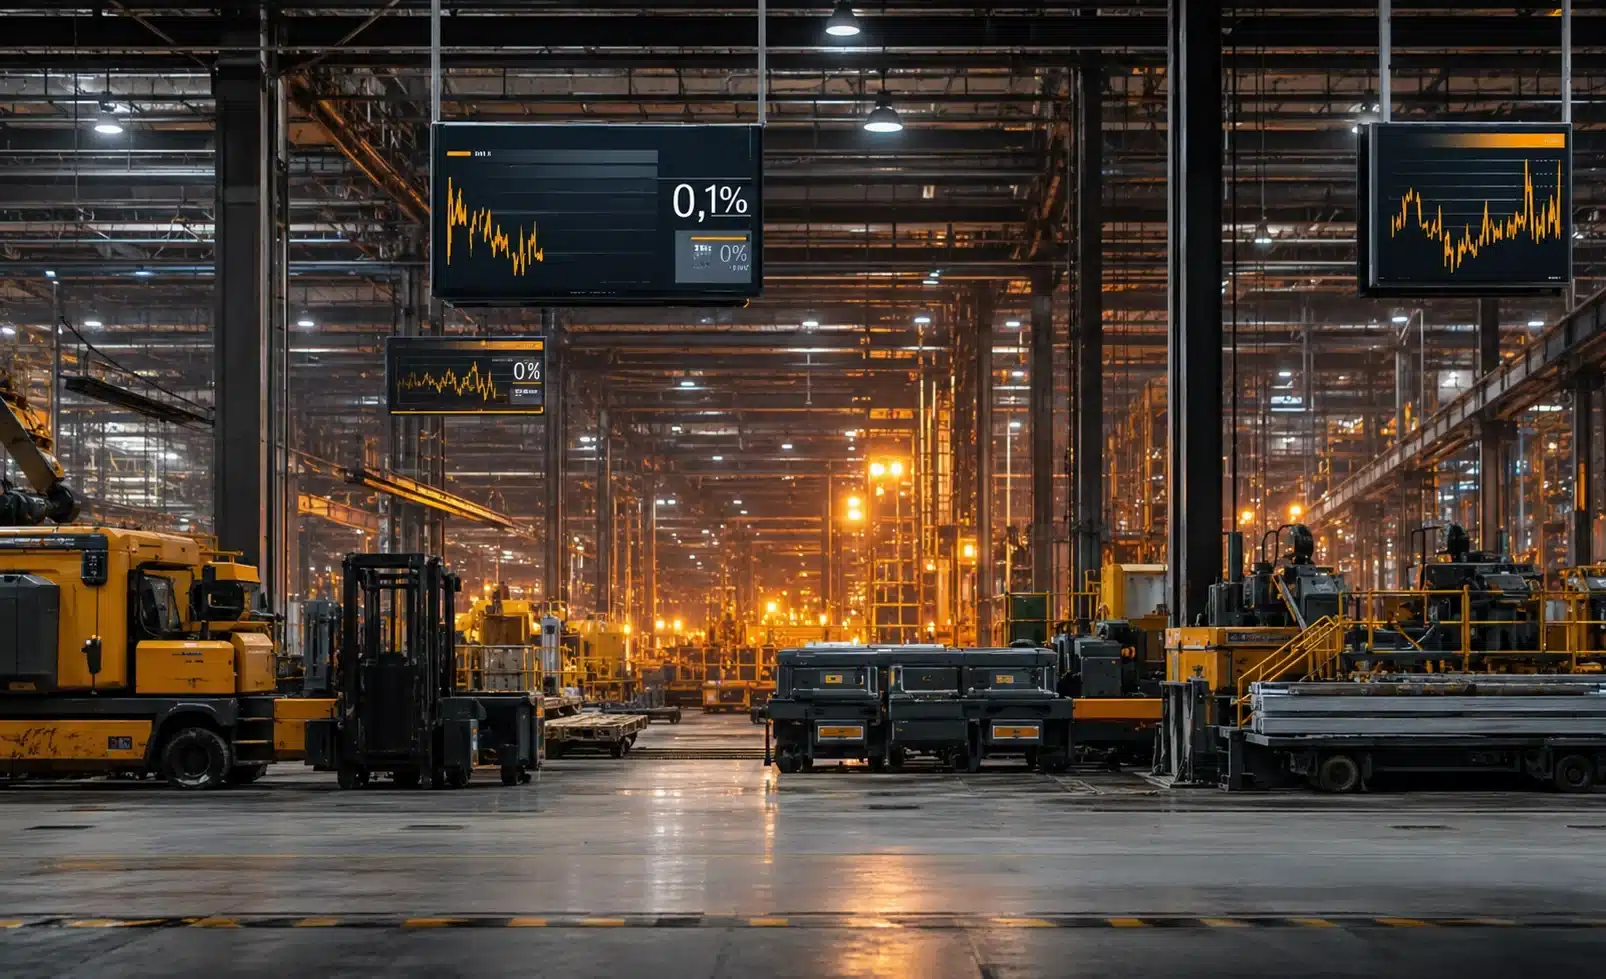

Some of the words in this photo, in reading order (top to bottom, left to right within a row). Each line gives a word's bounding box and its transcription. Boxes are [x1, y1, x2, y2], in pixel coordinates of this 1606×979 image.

[673, 183, 748, 223] 0,1%
[720, 244, 747, 263] 0%
[513, 362, 540, 380] 0%
